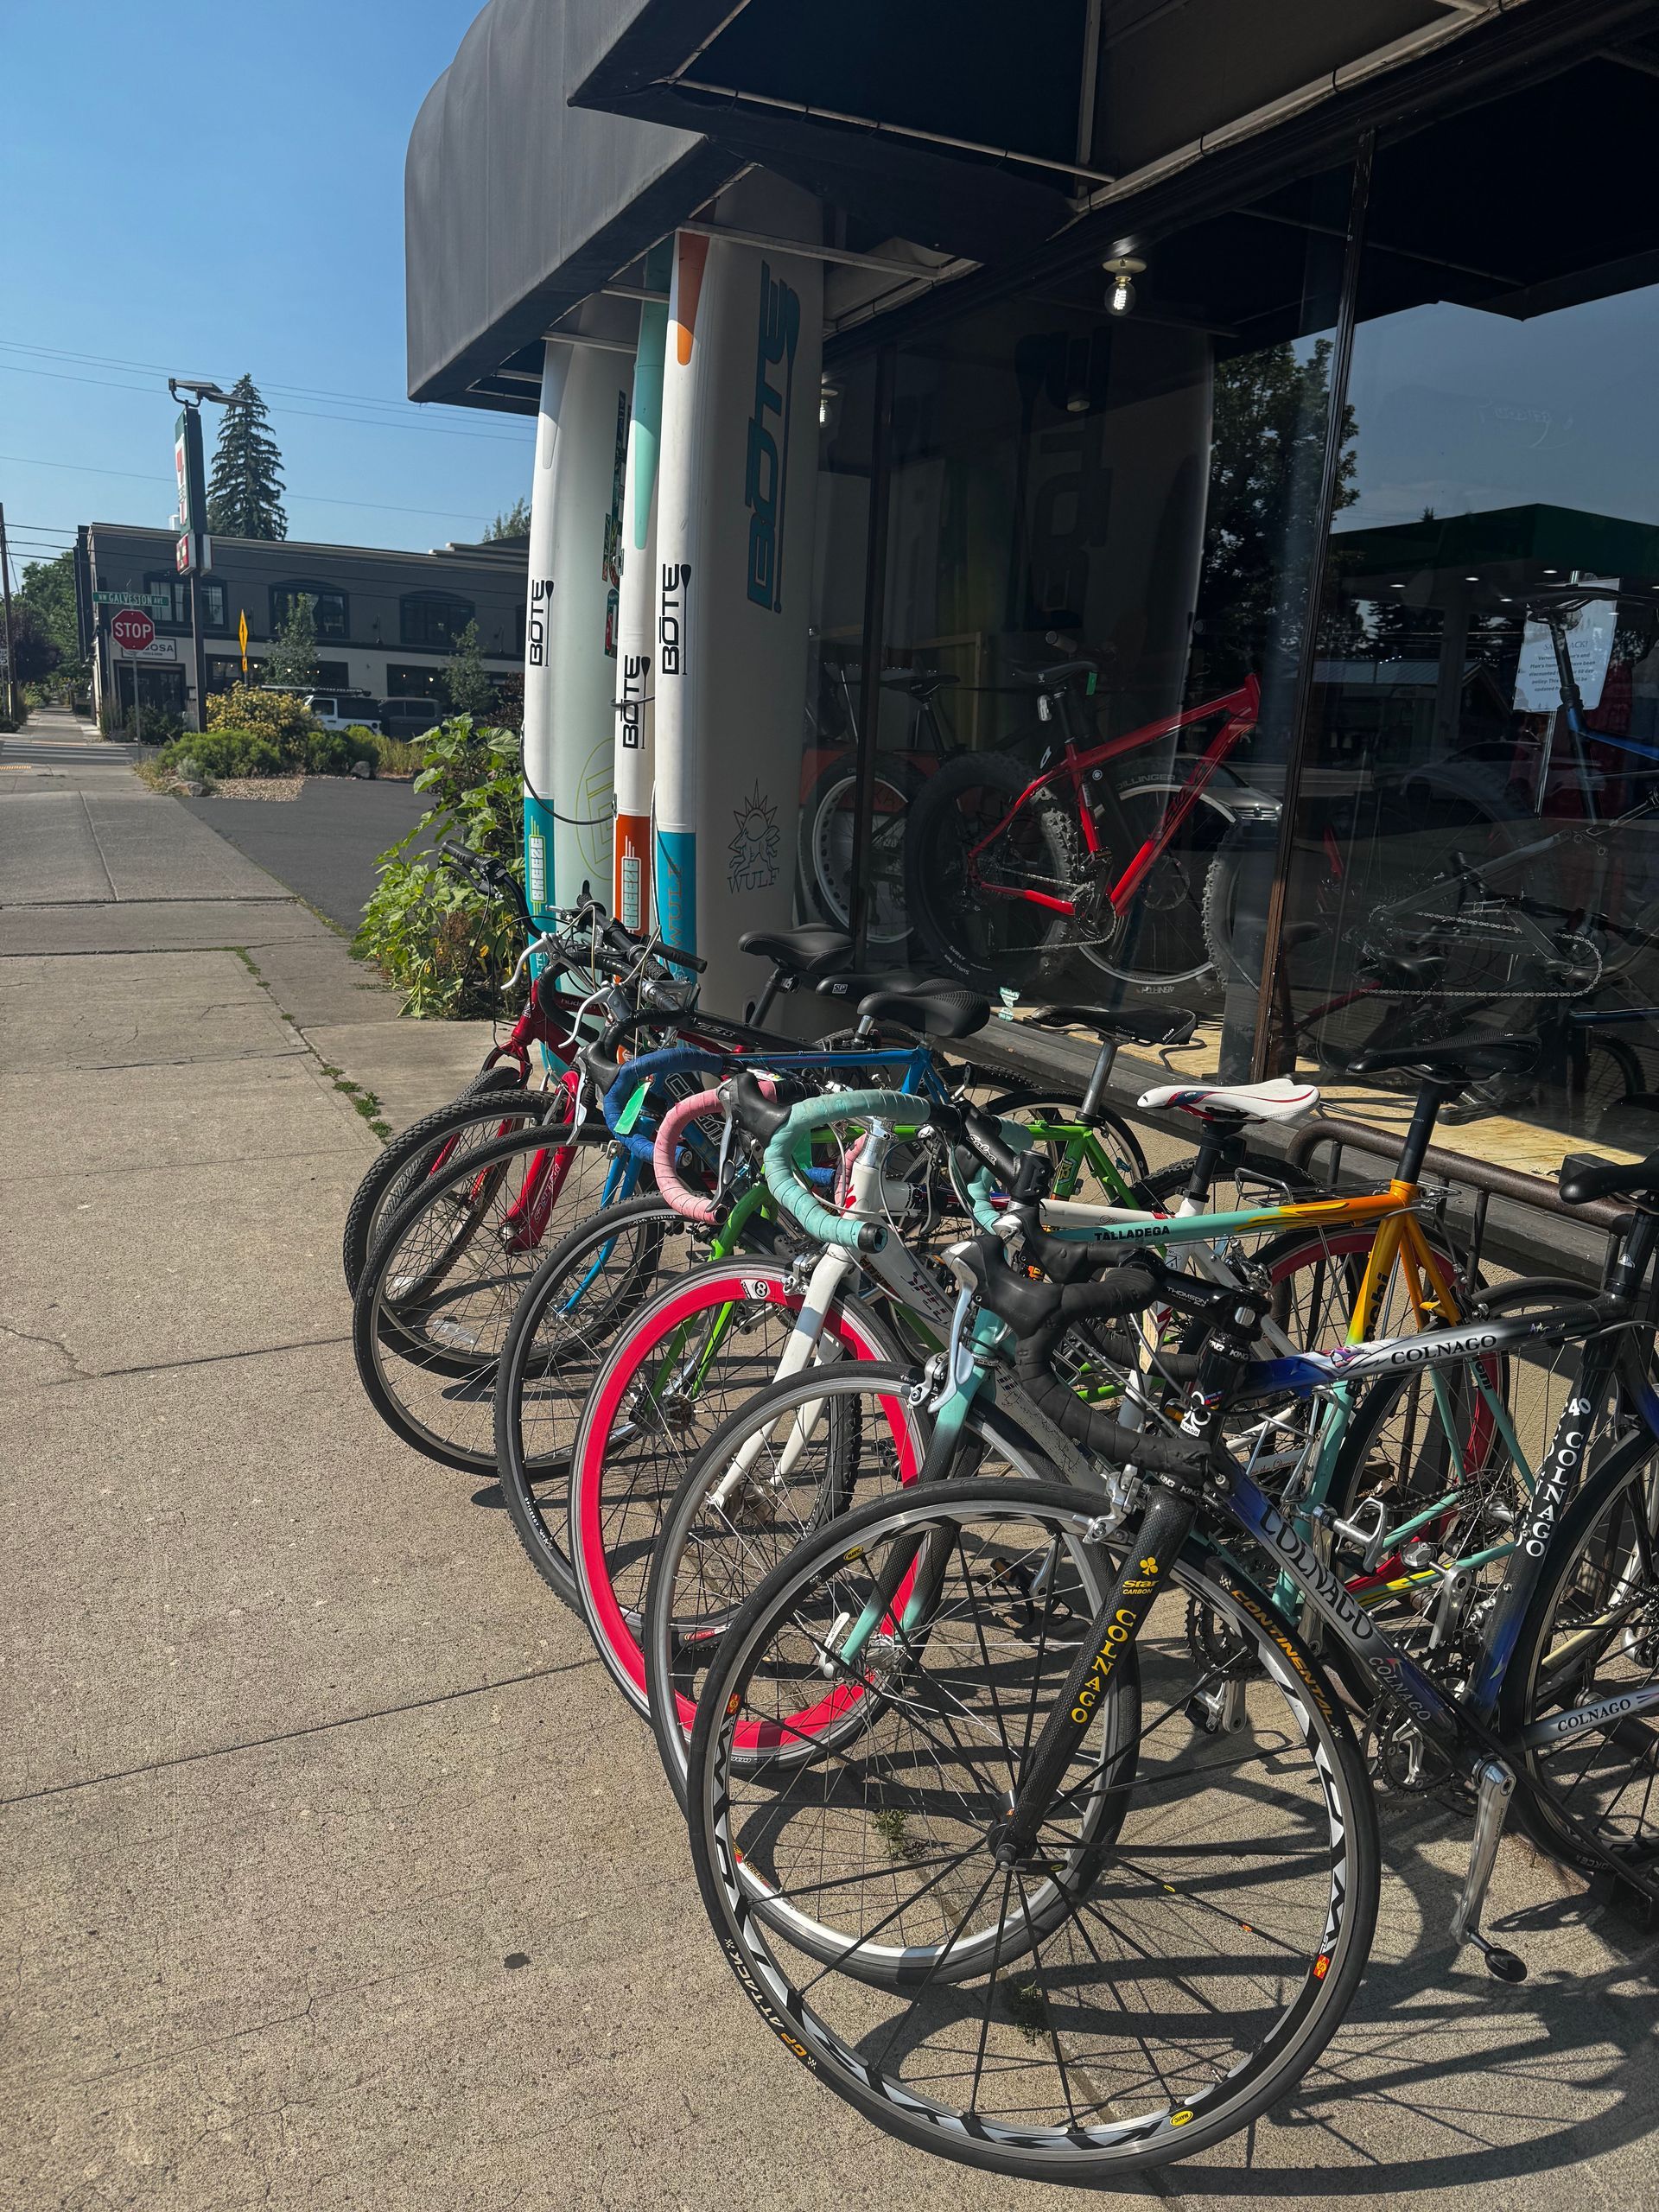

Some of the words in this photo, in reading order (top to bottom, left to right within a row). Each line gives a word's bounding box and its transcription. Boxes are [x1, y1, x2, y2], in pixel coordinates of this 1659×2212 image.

[109, 594, 152, 607] GALVESTON
[114, 622, 151, 639] STOP
[146, 643, 175, 652] OSA
[727, 867, 779, 894] WULF
[966, 1134, 997, 1166] Salsa
[1094, 1225, 1170, 1242] TALLADEGA
[1166, 1286, 1208, 1305] THOMSON
[1230, 1349, 1249, 1360] KING
[1391, 1335, 1497, 1365] COLNAGO
[1159, 1472, 1176, 1488] KING
[1180, 1485, 1200, 1497] KING
[1526, 1431, 1585, 1557] COLNAGO
[1122, 1580, 1160, 1588] Star
[1260, 1504, 1374, 1640] COLNAGO
[1071, 1608, 1137, 1724] COLNAGO
[1232, 1590, 1333, 1723] CONTINENTAL
[1368, 1656, 1431, 1721] COLNAGO
[1557, 1698, 1631, 1732] COLNAGO
[729, 1951, 785, 2029] ATTACK
[781, 2031, 808, 2057] GP
